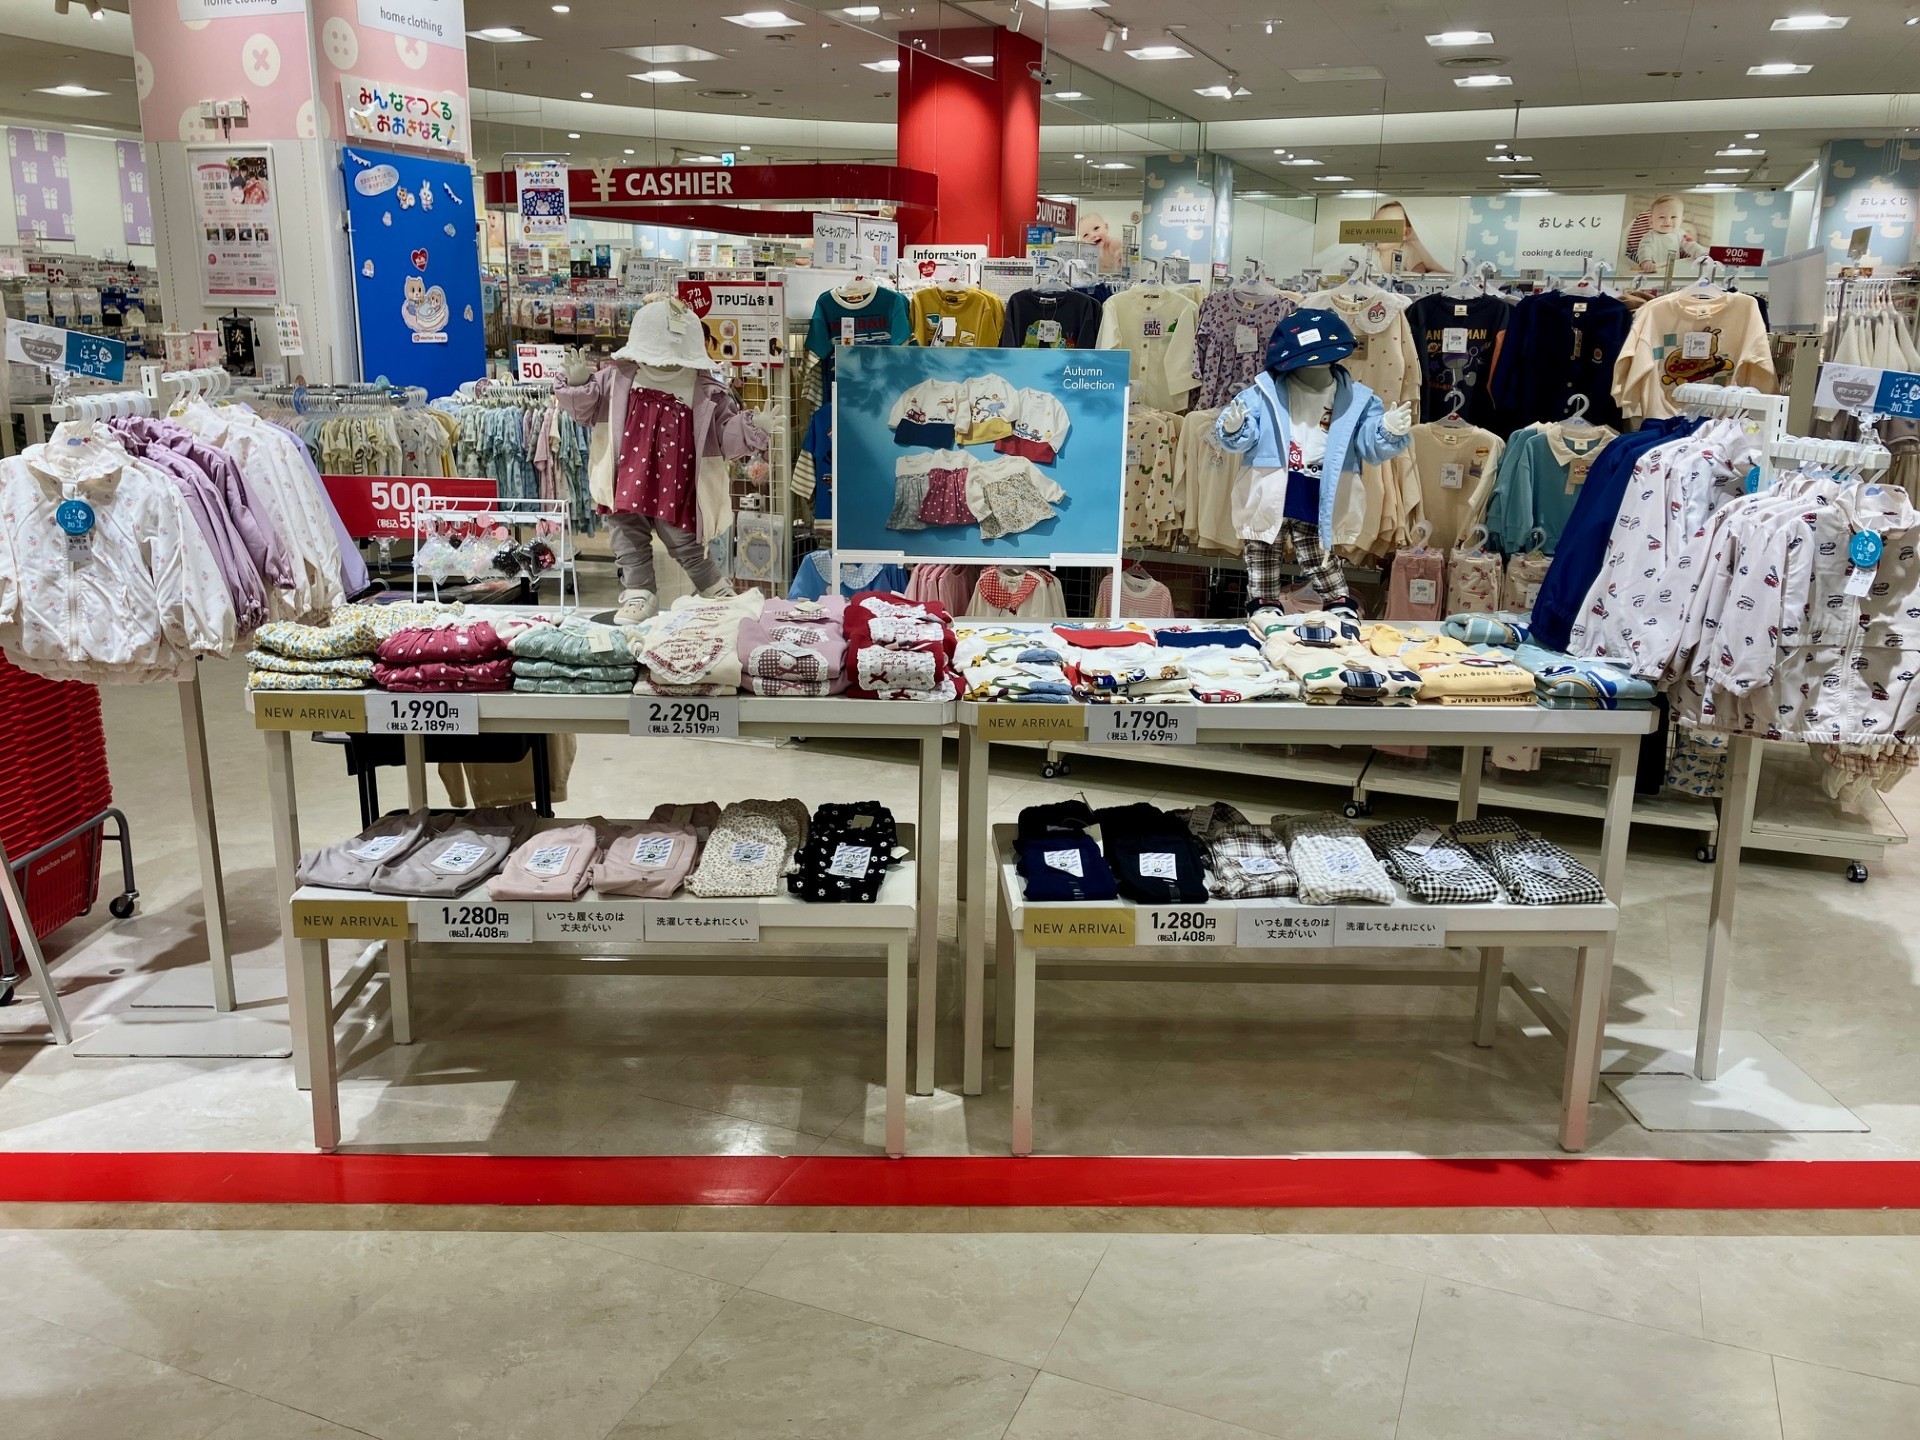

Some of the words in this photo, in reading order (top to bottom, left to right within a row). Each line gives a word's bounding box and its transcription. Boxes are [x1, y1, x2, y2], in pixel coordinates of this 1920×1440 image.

[380, 7, 405, 25] home
[407, 14, 443, 36] clothing
[359, 87, 453, 120] みんなでつくる
[625, 171, 734, 196] CASHIER
[1860, 197, 1908, 206] おしょくじ
[1539, 216, 1602, 228] おしょくじ
[1522, 249, 1554, 258] cooking
[1555, 249, 1562, 257] &
[1564, 249, 1593, 258] feeding
[1725, 248, 1749, 258] 900円
[82, 361, 106, 376] 加工
[523, 362, 543, 379] 50
[1063, 365, 1103, 376] Autumn
[1062, 378, 1115, 390] Collection
[1890, 401, 1914, 413] 加工
[371, 482, 447, 511] 500円
[265, 707, 293, 718] NEW
[300, 708, 355, 720] ARRIVAL
[391, 700, 459, 719] 1,990円
[649, 703, 719, 722] 2,290円
[989, 718, 1016, 728] NEW
[1021, 718, 1073, 728] ARRIVAL
[1113, 710, 1178, 729] 1,790円
[303, 915, 334, 926] NEW
[340, 916, 398, 927] ARRIVAL
[442, 906, 509, 925] 1,280円
[546, 911, 625, 922] いつも履くものは
[656, 916, 748, 926] 洗濯してもよれにくい
[1151, 911, 1216, 930] 1,280円
[560, 923, 612, 933] 丈夫がいい
[1033, 923, 1063, 934] NEW
[1069, 923, 1126, 934] ARRIVAL
[1254, 917, 1330, 928] いつも履くものは
[1346, 921, 1436, 932] 洗濯してもよれにくい
[1266, 929, 1317, 939] 丈夫がいい
